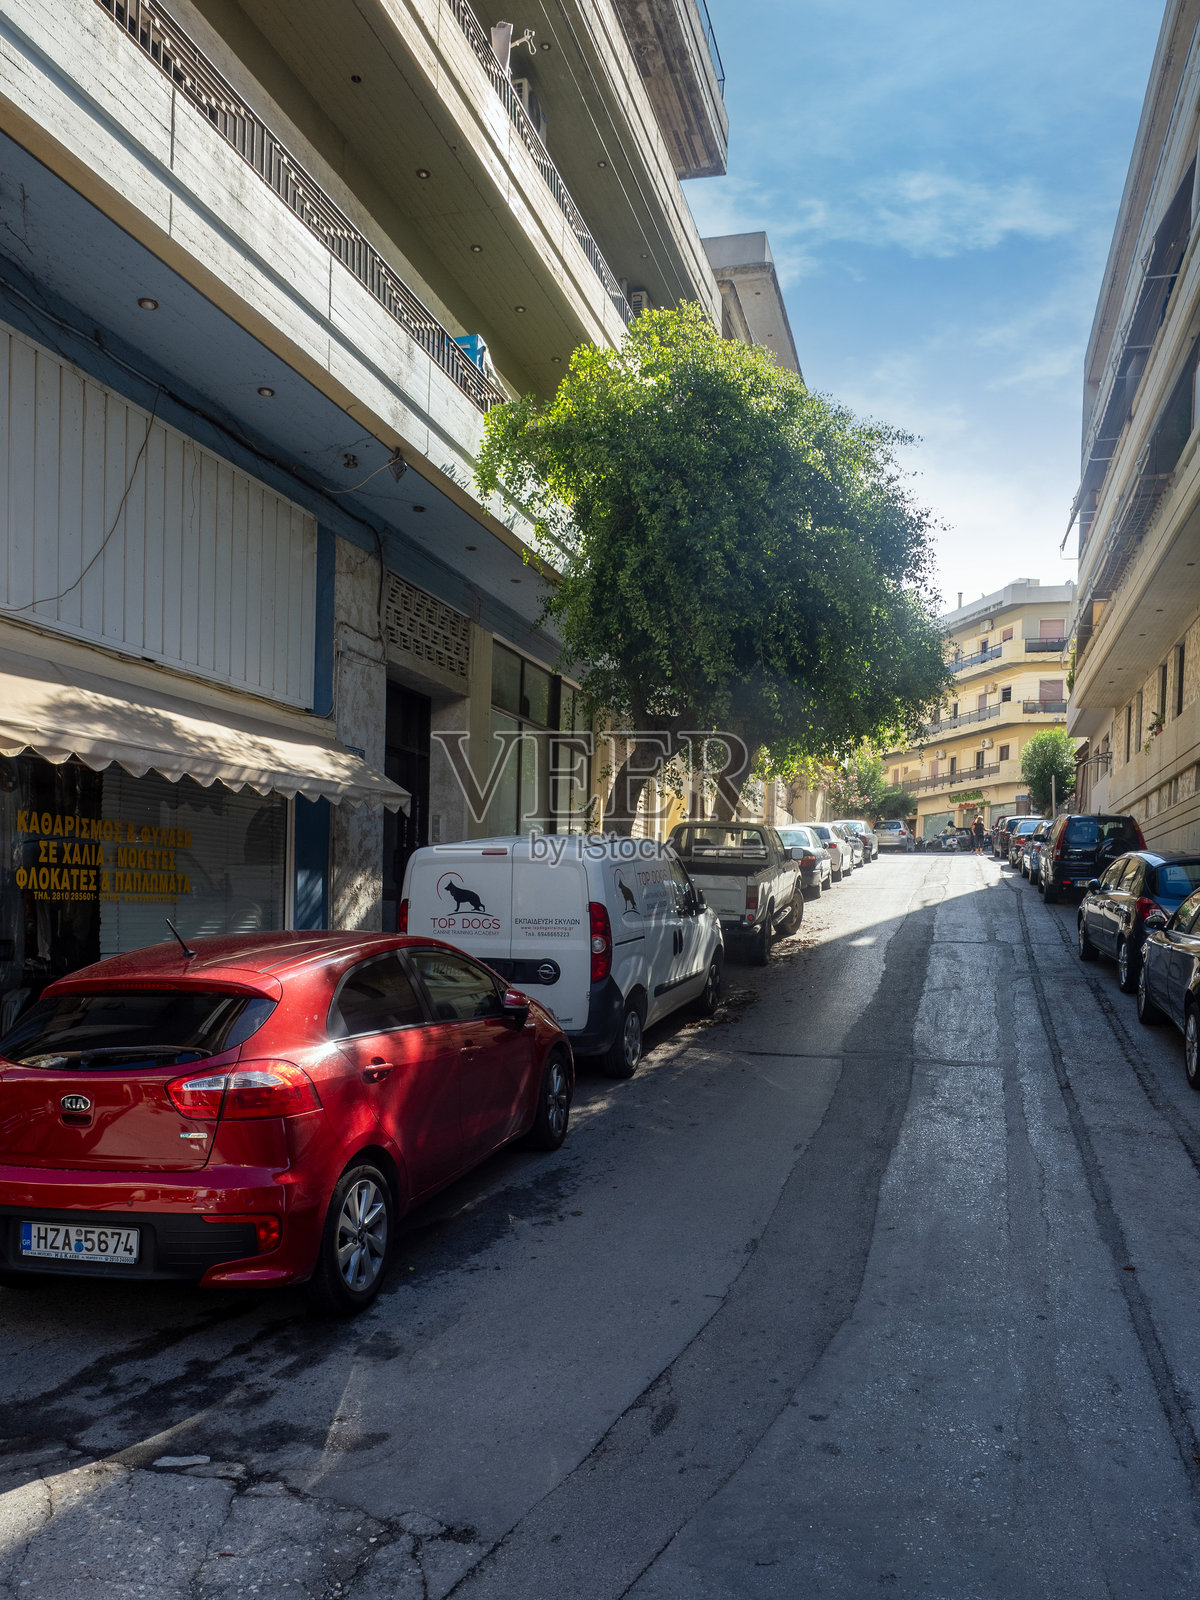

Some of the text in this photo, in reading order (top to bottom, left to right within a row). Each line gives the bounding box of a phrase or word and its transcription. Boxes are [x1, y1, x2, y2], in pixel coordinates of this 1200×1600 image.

[17, 809, 192, 849] ΚΑΘΑΡΙΣΜΟΣ & ΦΥΛΑΞΗ
[38, 840, 58, 863] ΣΕ
[62, 842, 105, 866] ΧΑΛΙΑ
[117, 847, 176, 871] ΜΟΚΕΤΕΣ
[15, 866, 191, 893] ΦΛΟΚΑΤΕΣ & ΠΑΠΛΩΜΑΤΑ
[34, 891, 50, 900] ΤΗΛ.
[52, 892, 69, 900] 2810
[430, 917, 501, 930] TOP DOGS
[64, 1098, 86, 1110] KIA
